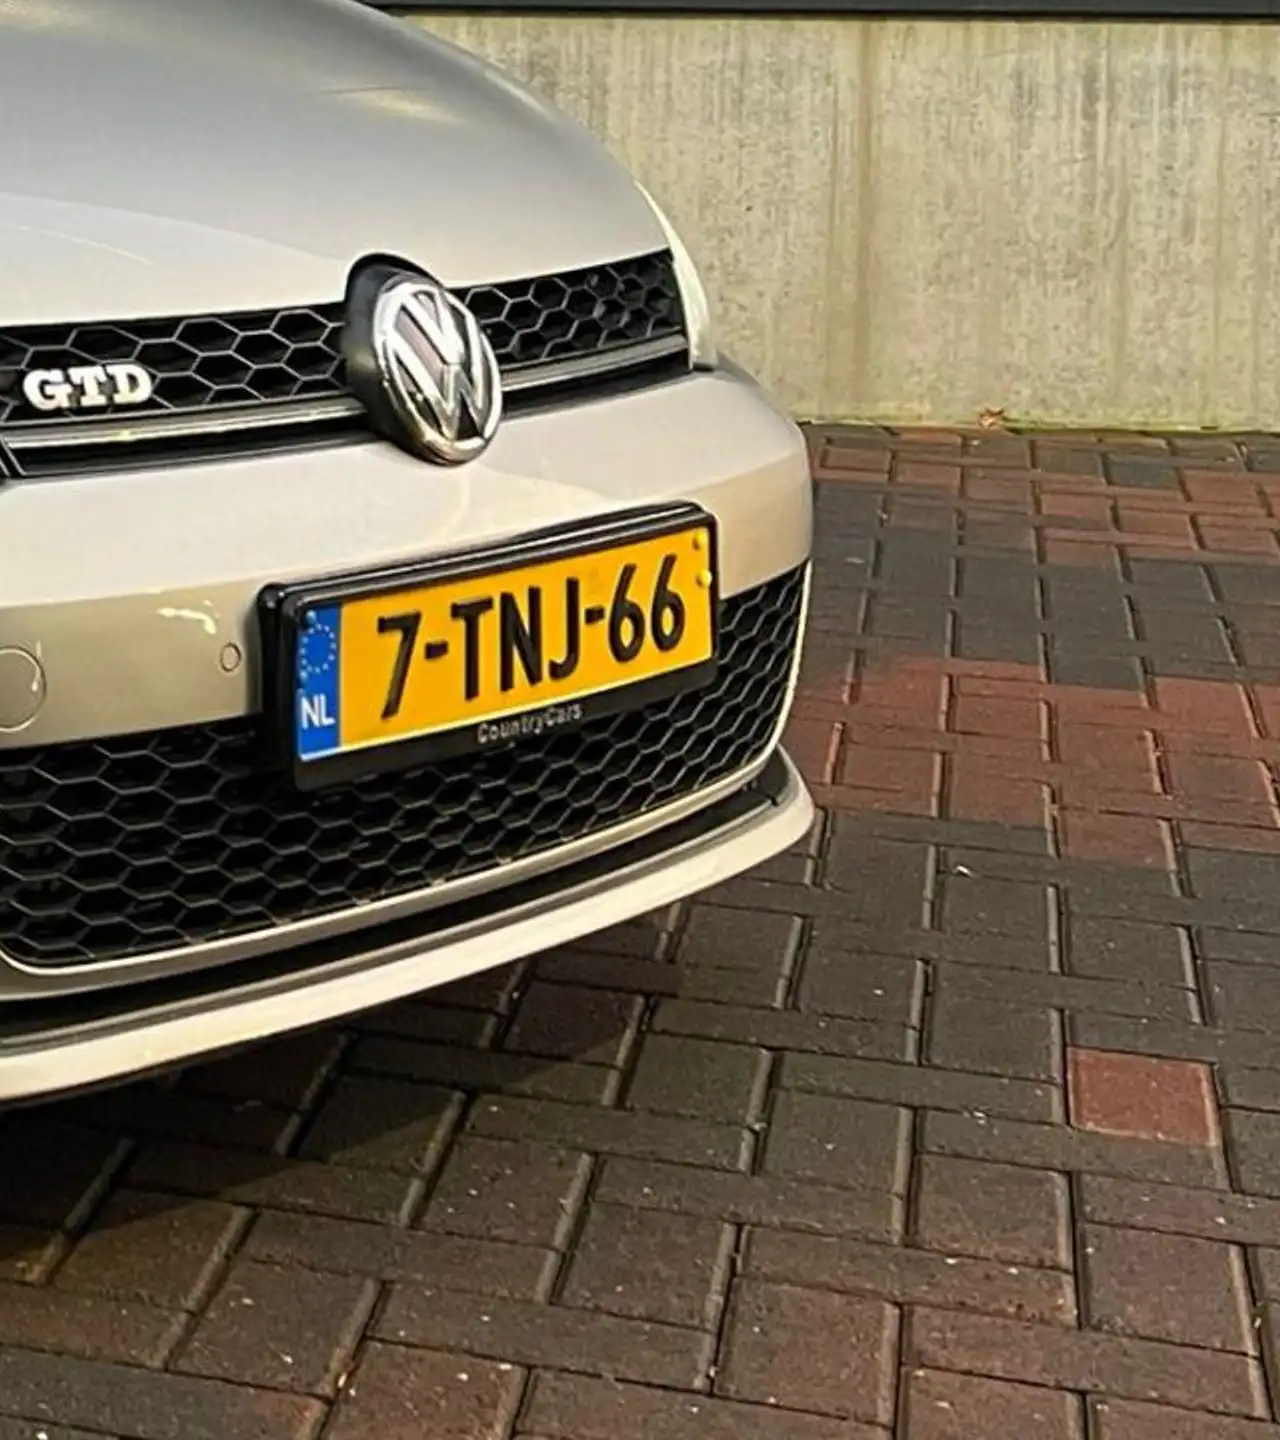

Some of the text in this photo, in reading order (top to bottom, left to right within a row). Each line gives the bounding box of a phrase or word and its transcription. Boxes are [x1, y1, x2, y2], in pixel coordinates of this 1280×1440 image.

[23, 364, 152, 410] GTD
[377, 553, 685, 720] 7-TNJ-66
[301, 693, 336, 729] NL
